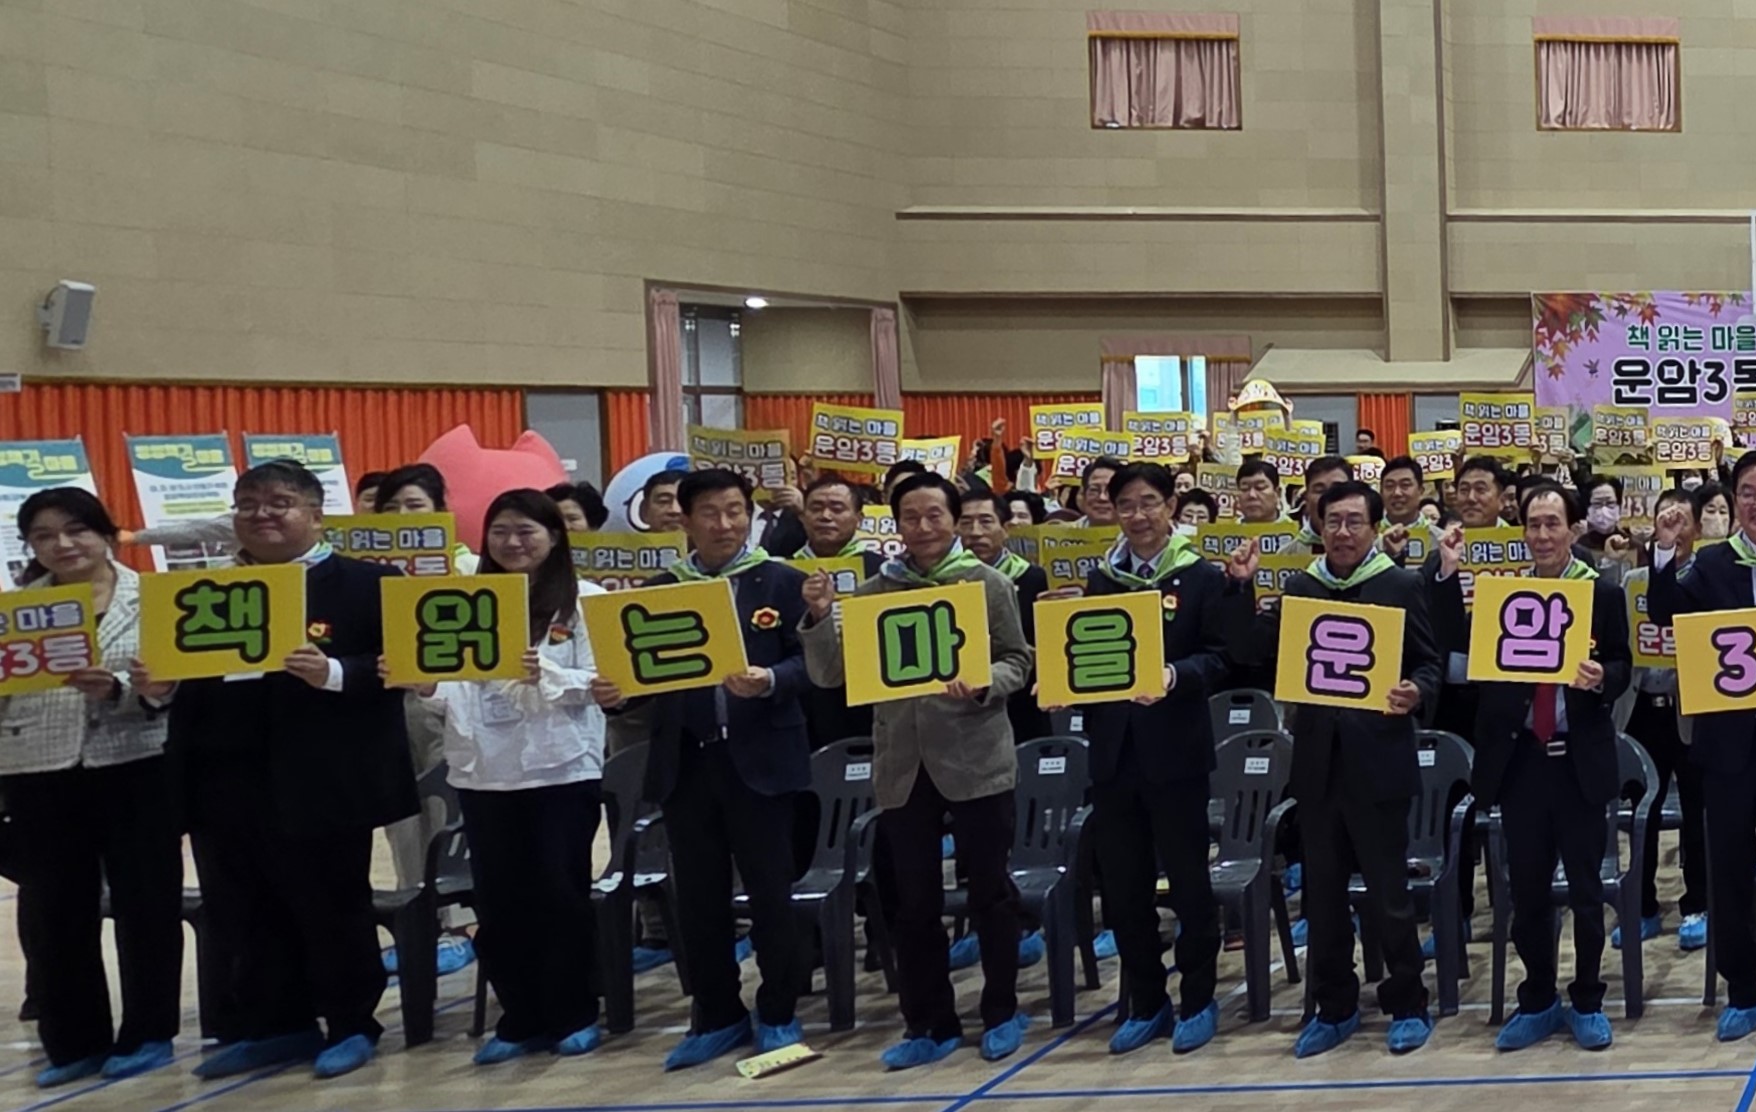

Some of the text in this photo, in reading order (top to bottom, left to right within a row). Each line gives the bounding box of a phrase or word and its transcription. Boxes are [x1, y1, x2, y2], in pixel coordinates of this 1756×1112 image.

[1627, 324, 1756, 351] 책 읽는 마을
[1505, 403, 1530, 419] 마을
[865, 418, 898, 437] 마을
[1463, 420, 1531, 448] 운암3동
[1595, 427, 1646, 447] 운암3동
[813, 435, 897, 466] 운암3동
[1655, 440, 1713, 461] 운암3동
[349, 526, 446, 553] 읽는 마을
[1471, 541, 1506, 563] 읽는
[592, 546, 680, 571] 읽는 마을
[16, 600, 83, 633] 마을
[174, 579, 270, 666] 책
[416, 588, 499, 675] 읽
[623, 603, 713, 687] 는
[877, 599, 966, 690] 마
[1498, 590, 1574, 673] 암
[1066, 608, 1136, 695] 을
[1305, 613, 1377, 700] 운
